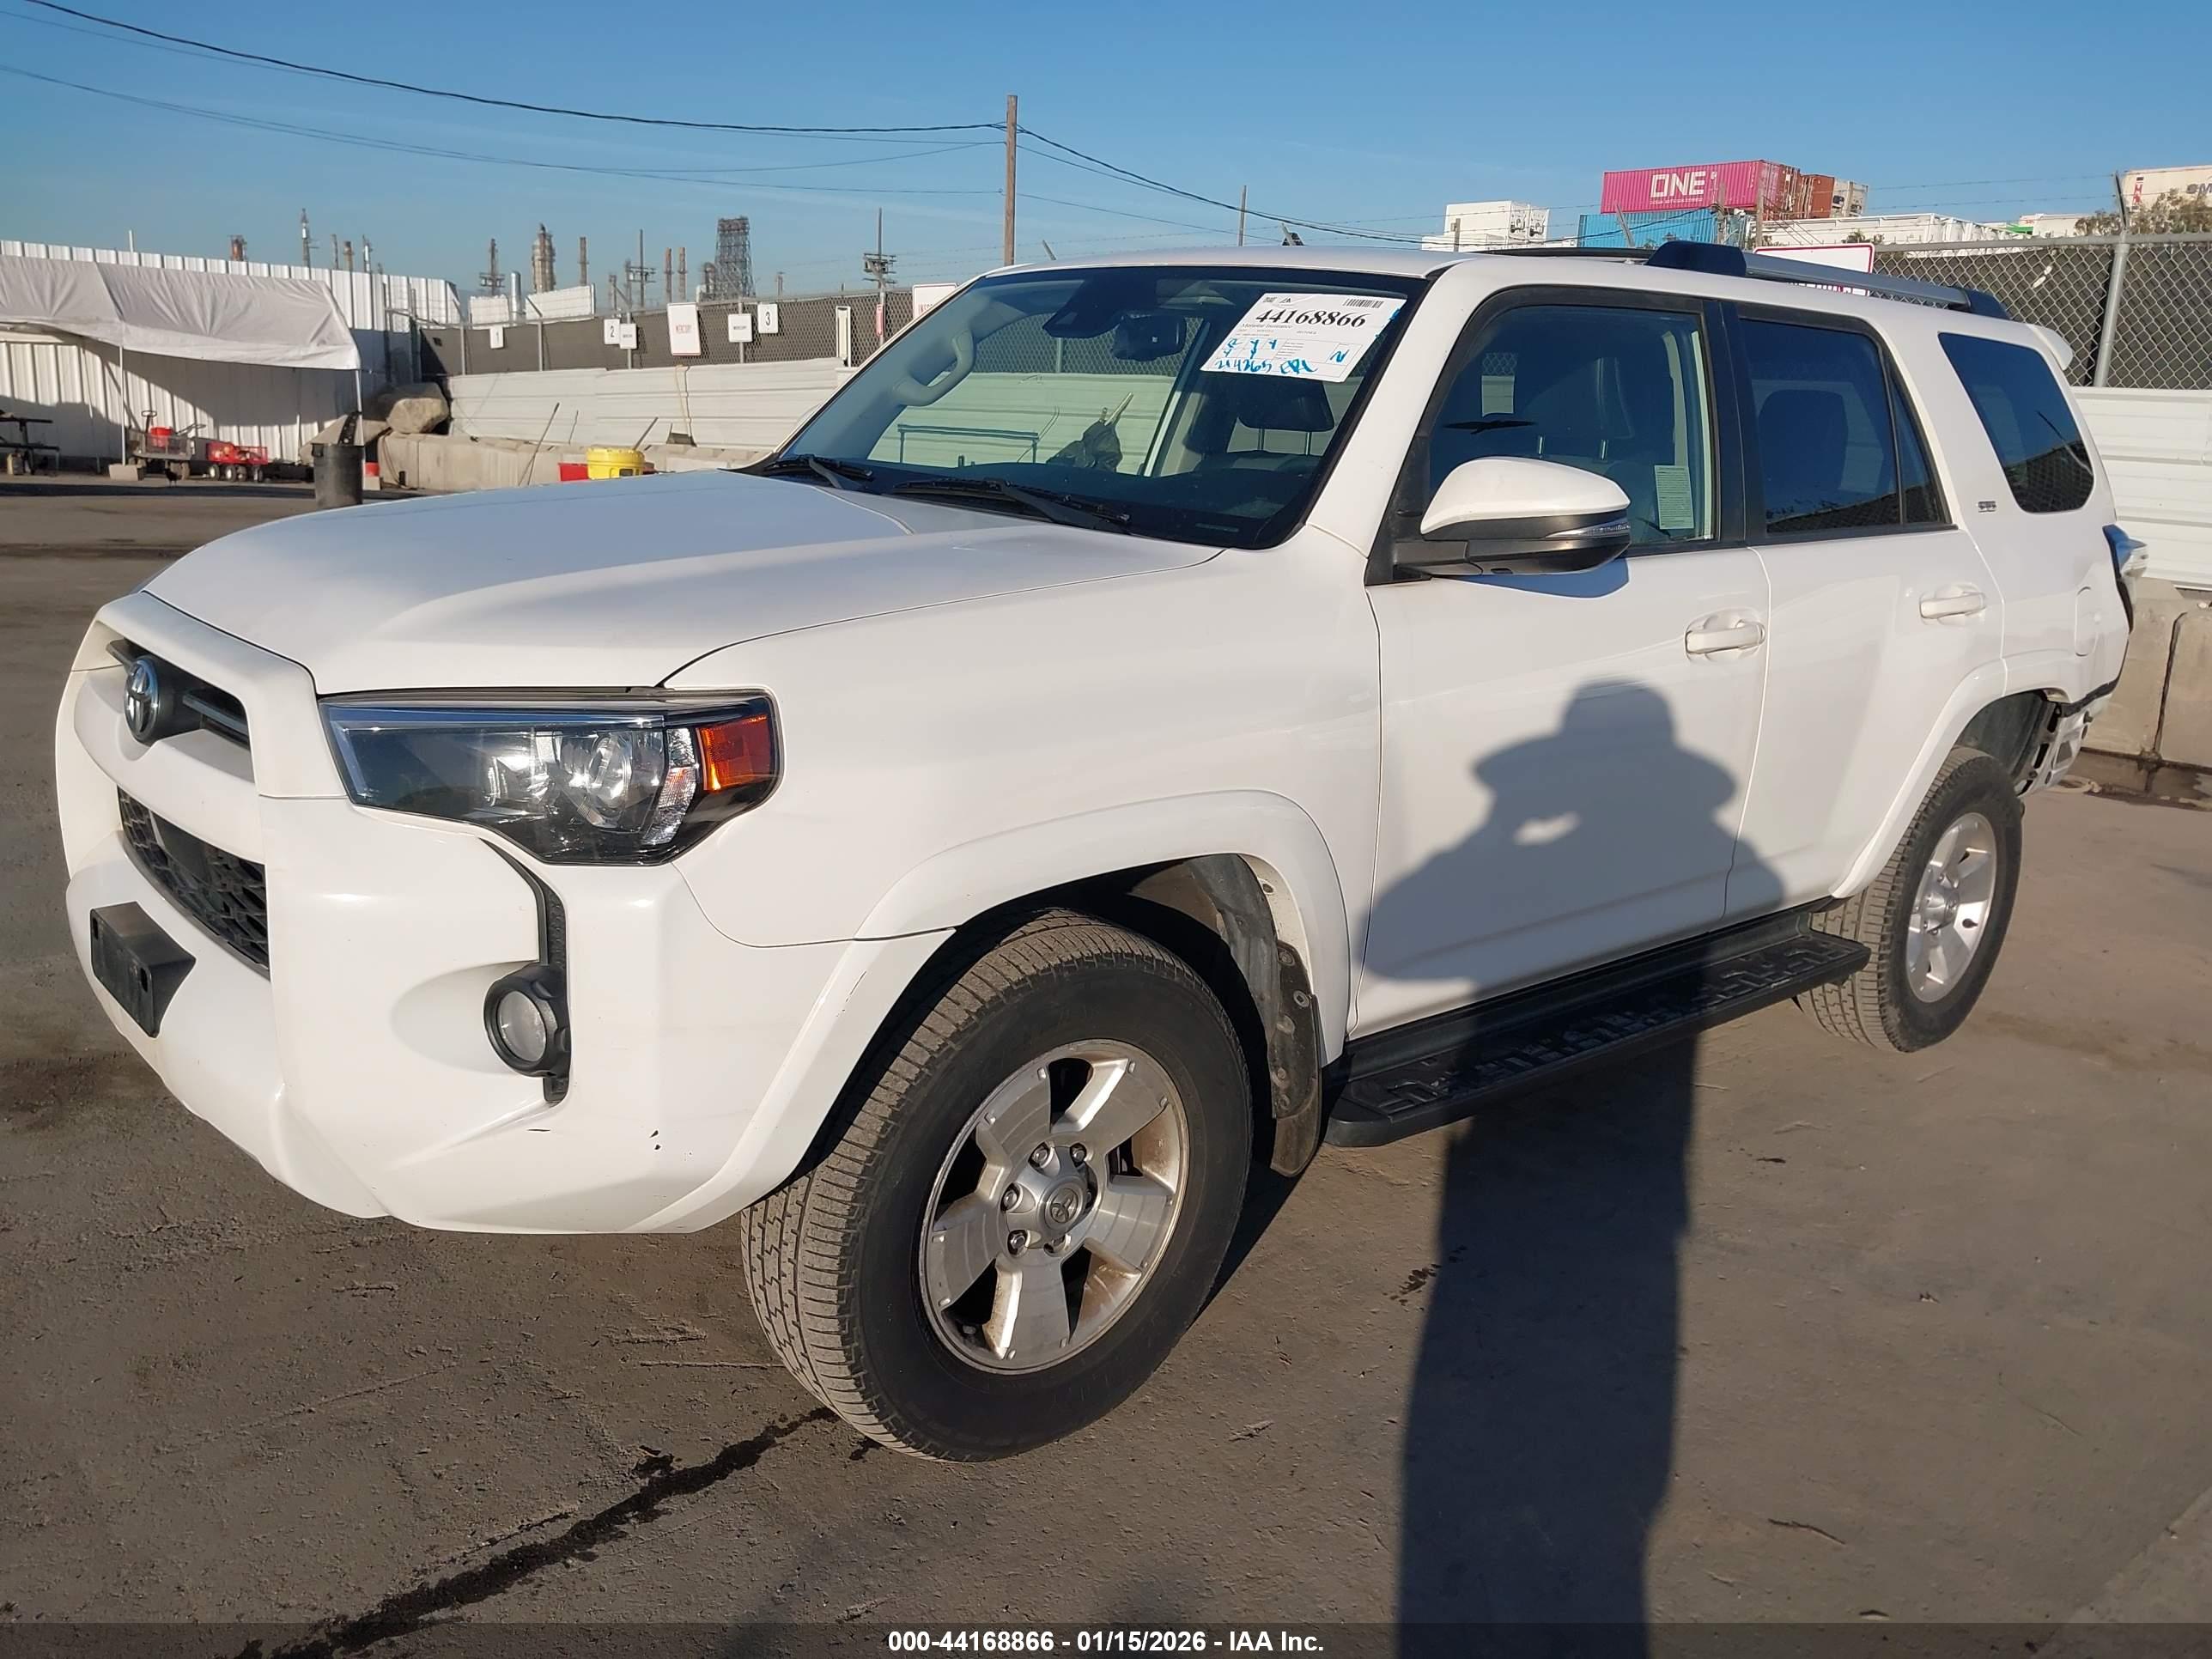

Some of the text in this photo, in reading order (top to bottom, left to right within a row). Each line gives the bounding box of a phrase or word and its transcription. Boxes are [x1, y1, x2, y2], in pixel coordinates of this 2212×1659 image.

[1650, 171, 1706, 198] ONE
[764, 311, 771, 326] 3
[1255, 308, 1368, 328] 44168866
[610, 325, 615, 338] 2
